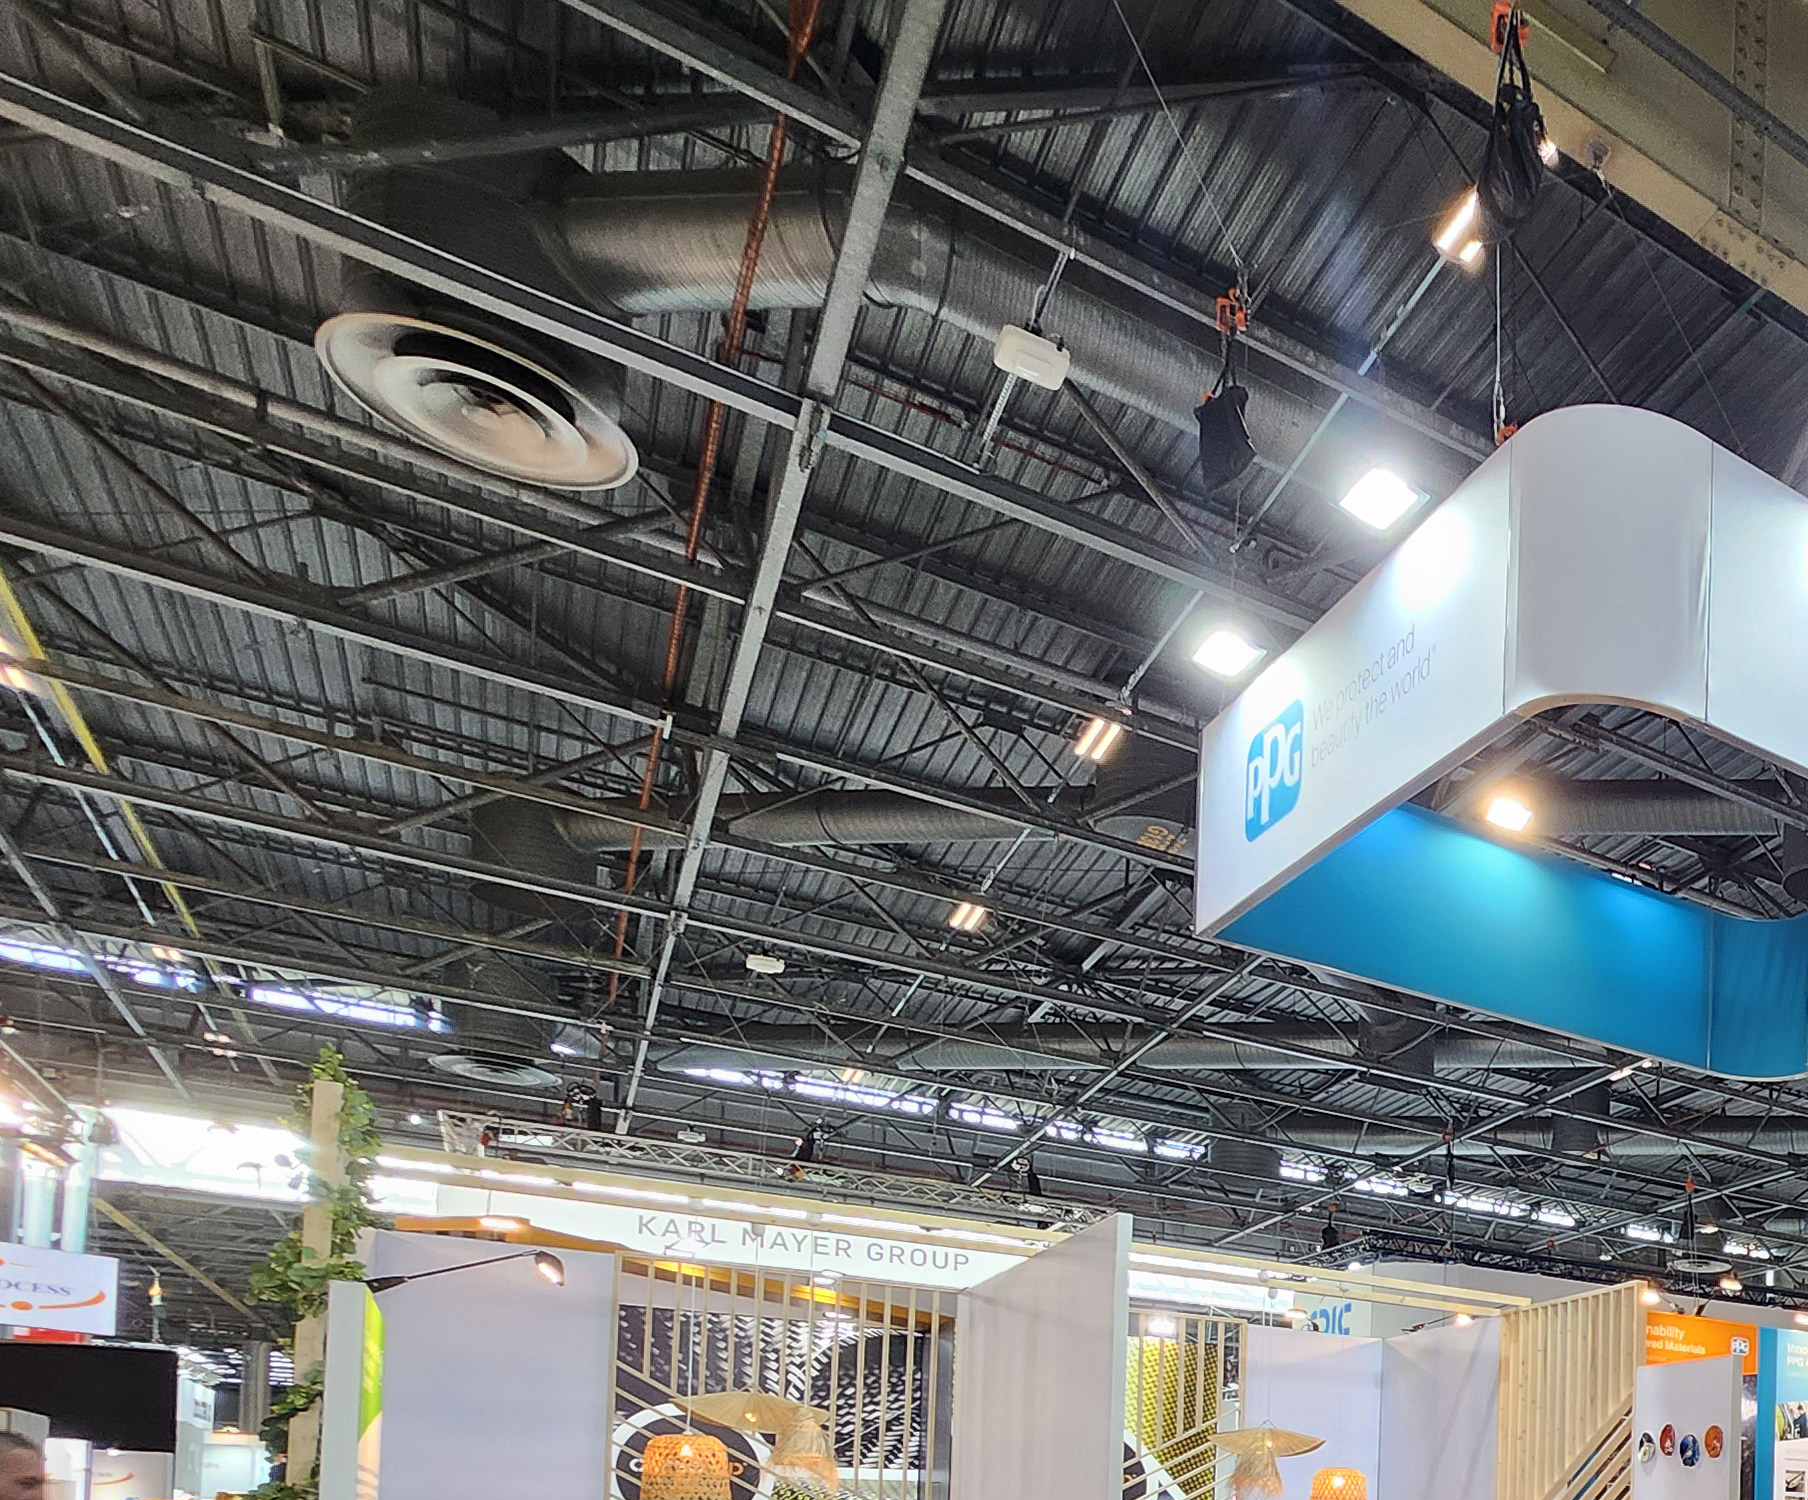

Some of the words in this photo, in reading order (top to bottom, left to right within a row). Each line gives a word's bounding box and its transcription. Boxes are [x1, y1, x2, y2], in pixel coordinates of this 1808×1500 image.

[1312, 700, 1334, 731] We
[1336, 651, 1385, 717] protect
[1387, 623, 1415, 670] and
[1310, 709, 1363, 769] beautify
[1365, 690, 1388, 725] the
[1247, 721, 1302, 826] PPG
[637, 1213, 728, 1245] KARL
[741, 1226, 853, 1260] MAYER
[865, 1242, 970, 1272] GROUP
[1665, 1340, 1707, 1356] Materials
[1732, 1339, 1748, 1354] PPG
[1786, 1356, 1805, 1367] PPG
